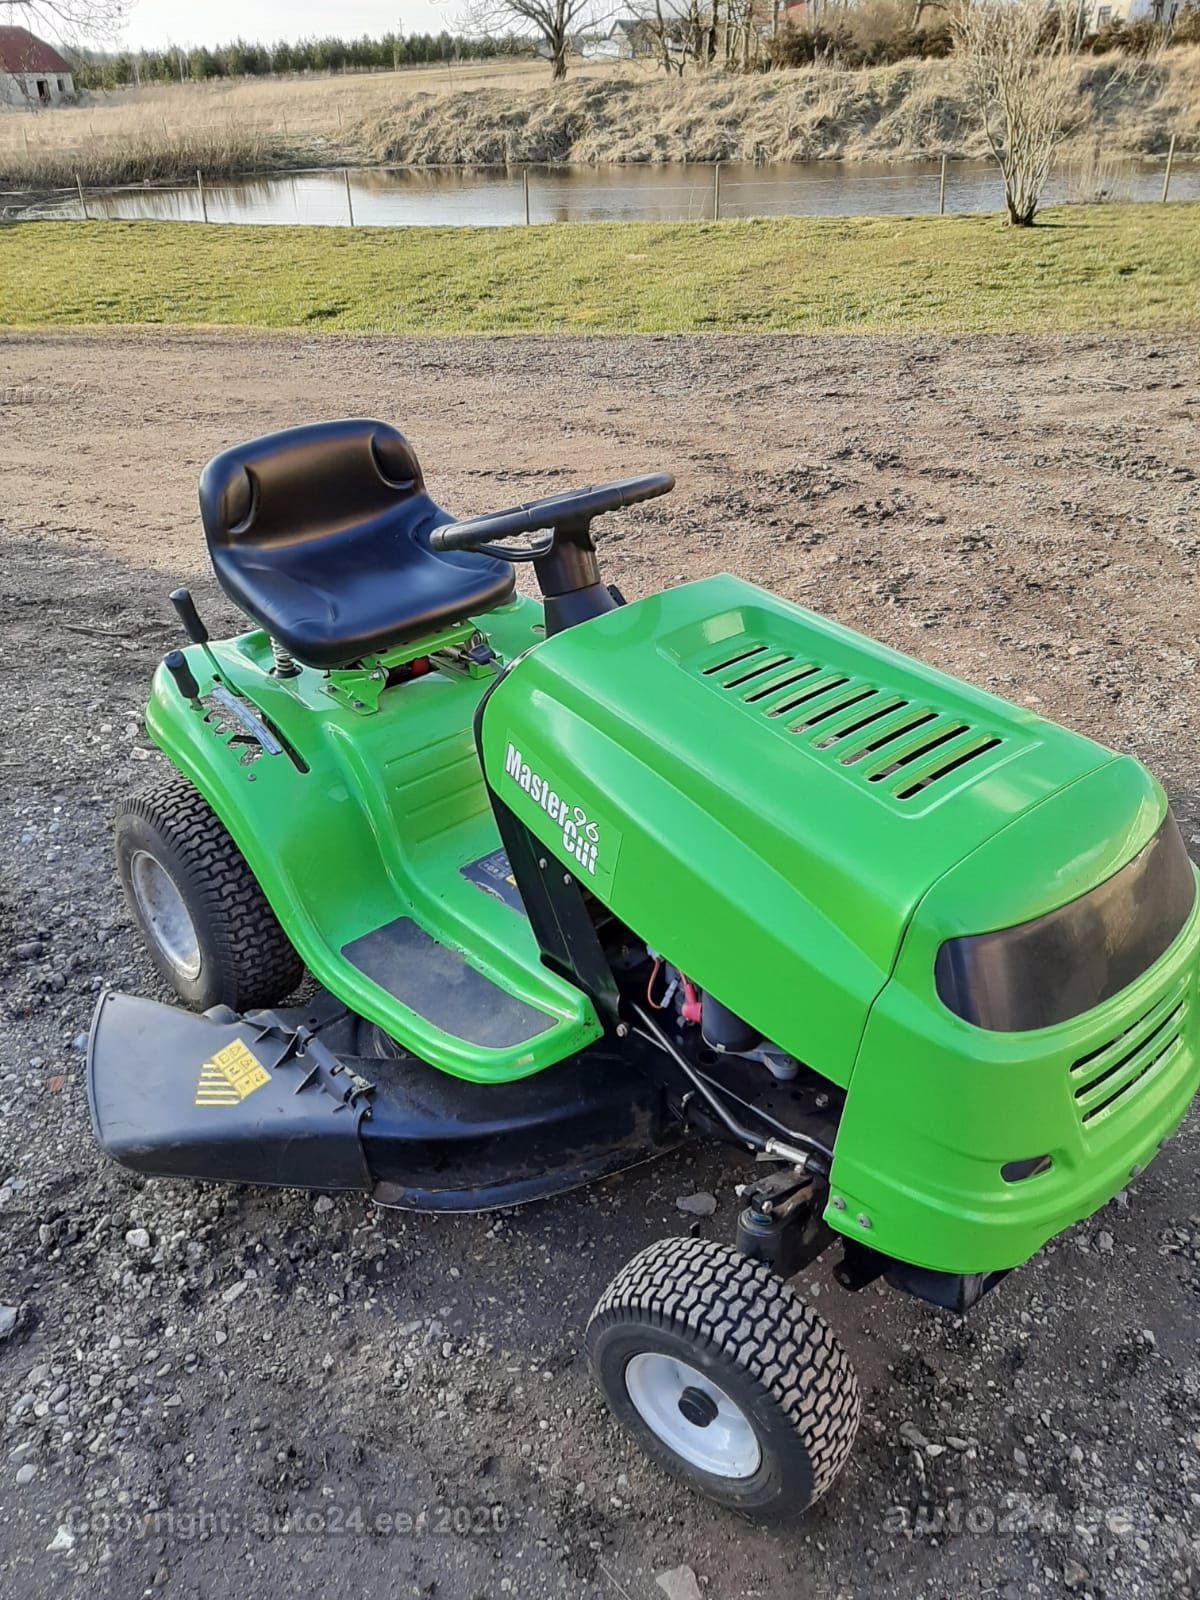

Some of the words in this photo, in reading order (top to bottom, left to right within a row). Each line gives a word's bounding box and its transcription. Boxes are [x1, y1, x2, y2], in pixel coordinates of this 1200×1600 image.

[505, 742, 570, 827] Master
[562, 819, 599, 876] Cut
[573, 806, 599, 842] 96
